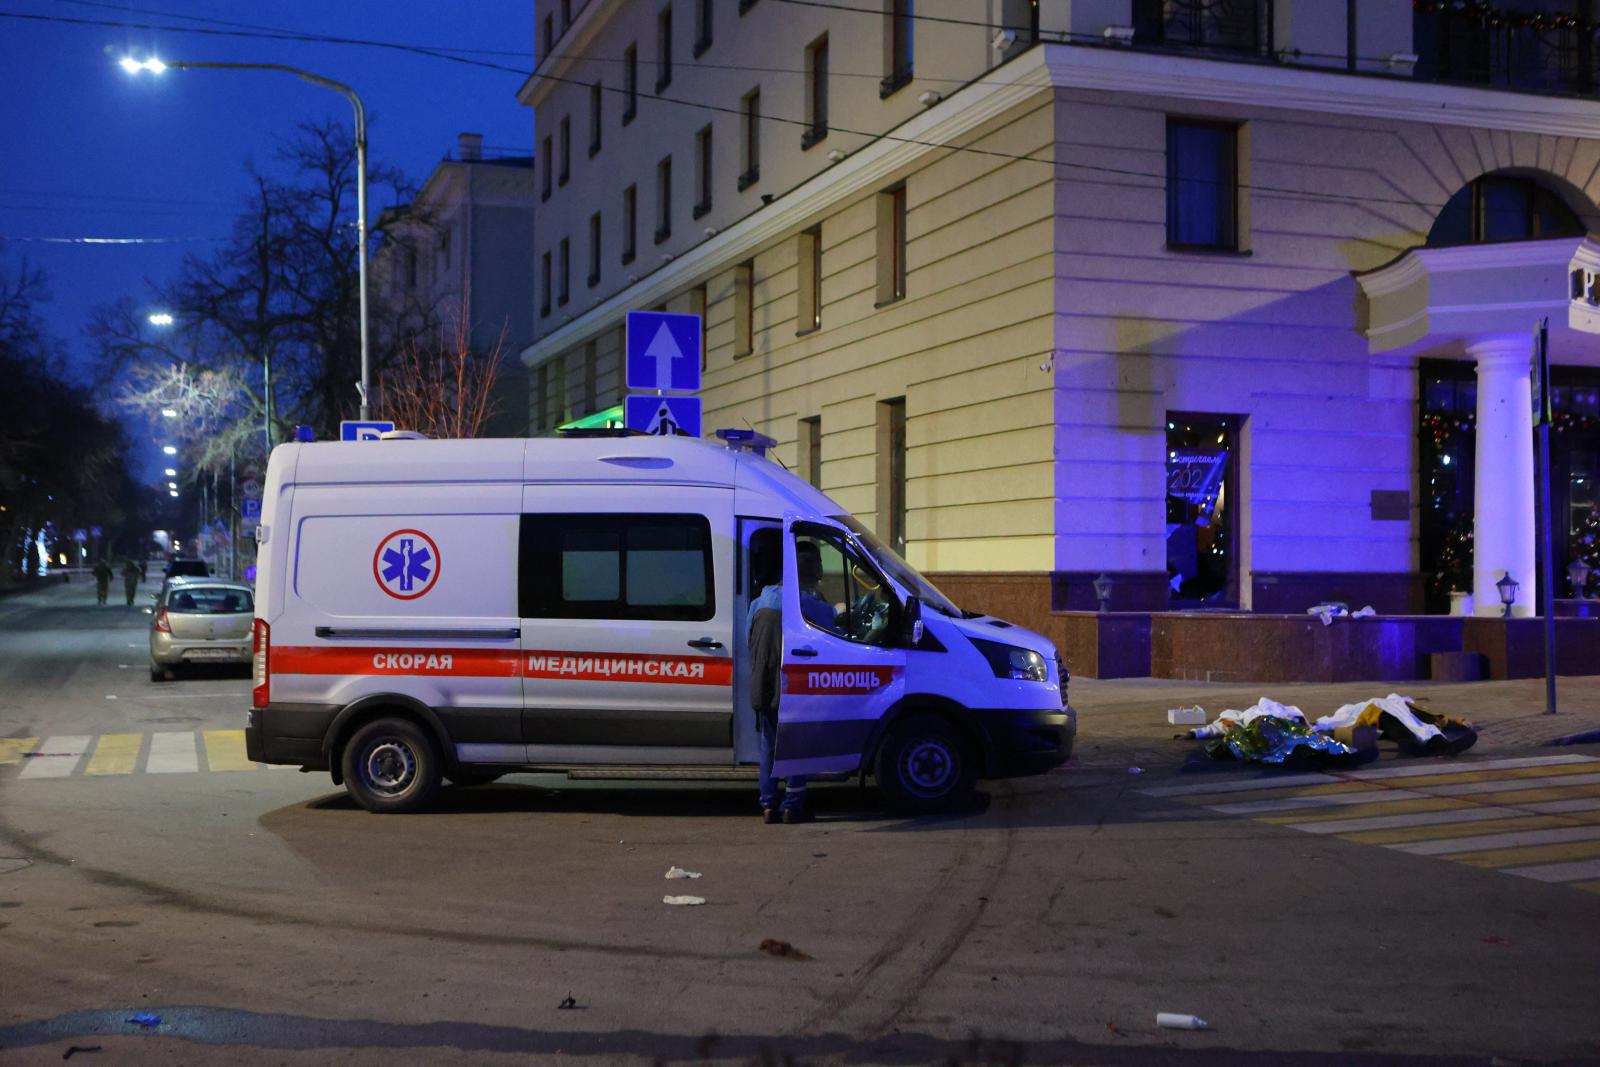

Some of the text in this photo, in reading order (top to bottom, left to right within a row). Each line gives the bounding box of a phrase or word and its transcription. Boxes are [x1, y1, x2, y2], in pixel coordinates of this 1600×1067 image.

[1170, 468, 1207, 489] 202
[246, 499, 258, 516] P
[372, 653, 881, 691] СКОРАЯ МЕДИЦИНСКАЯ ПОМОЩЬ
